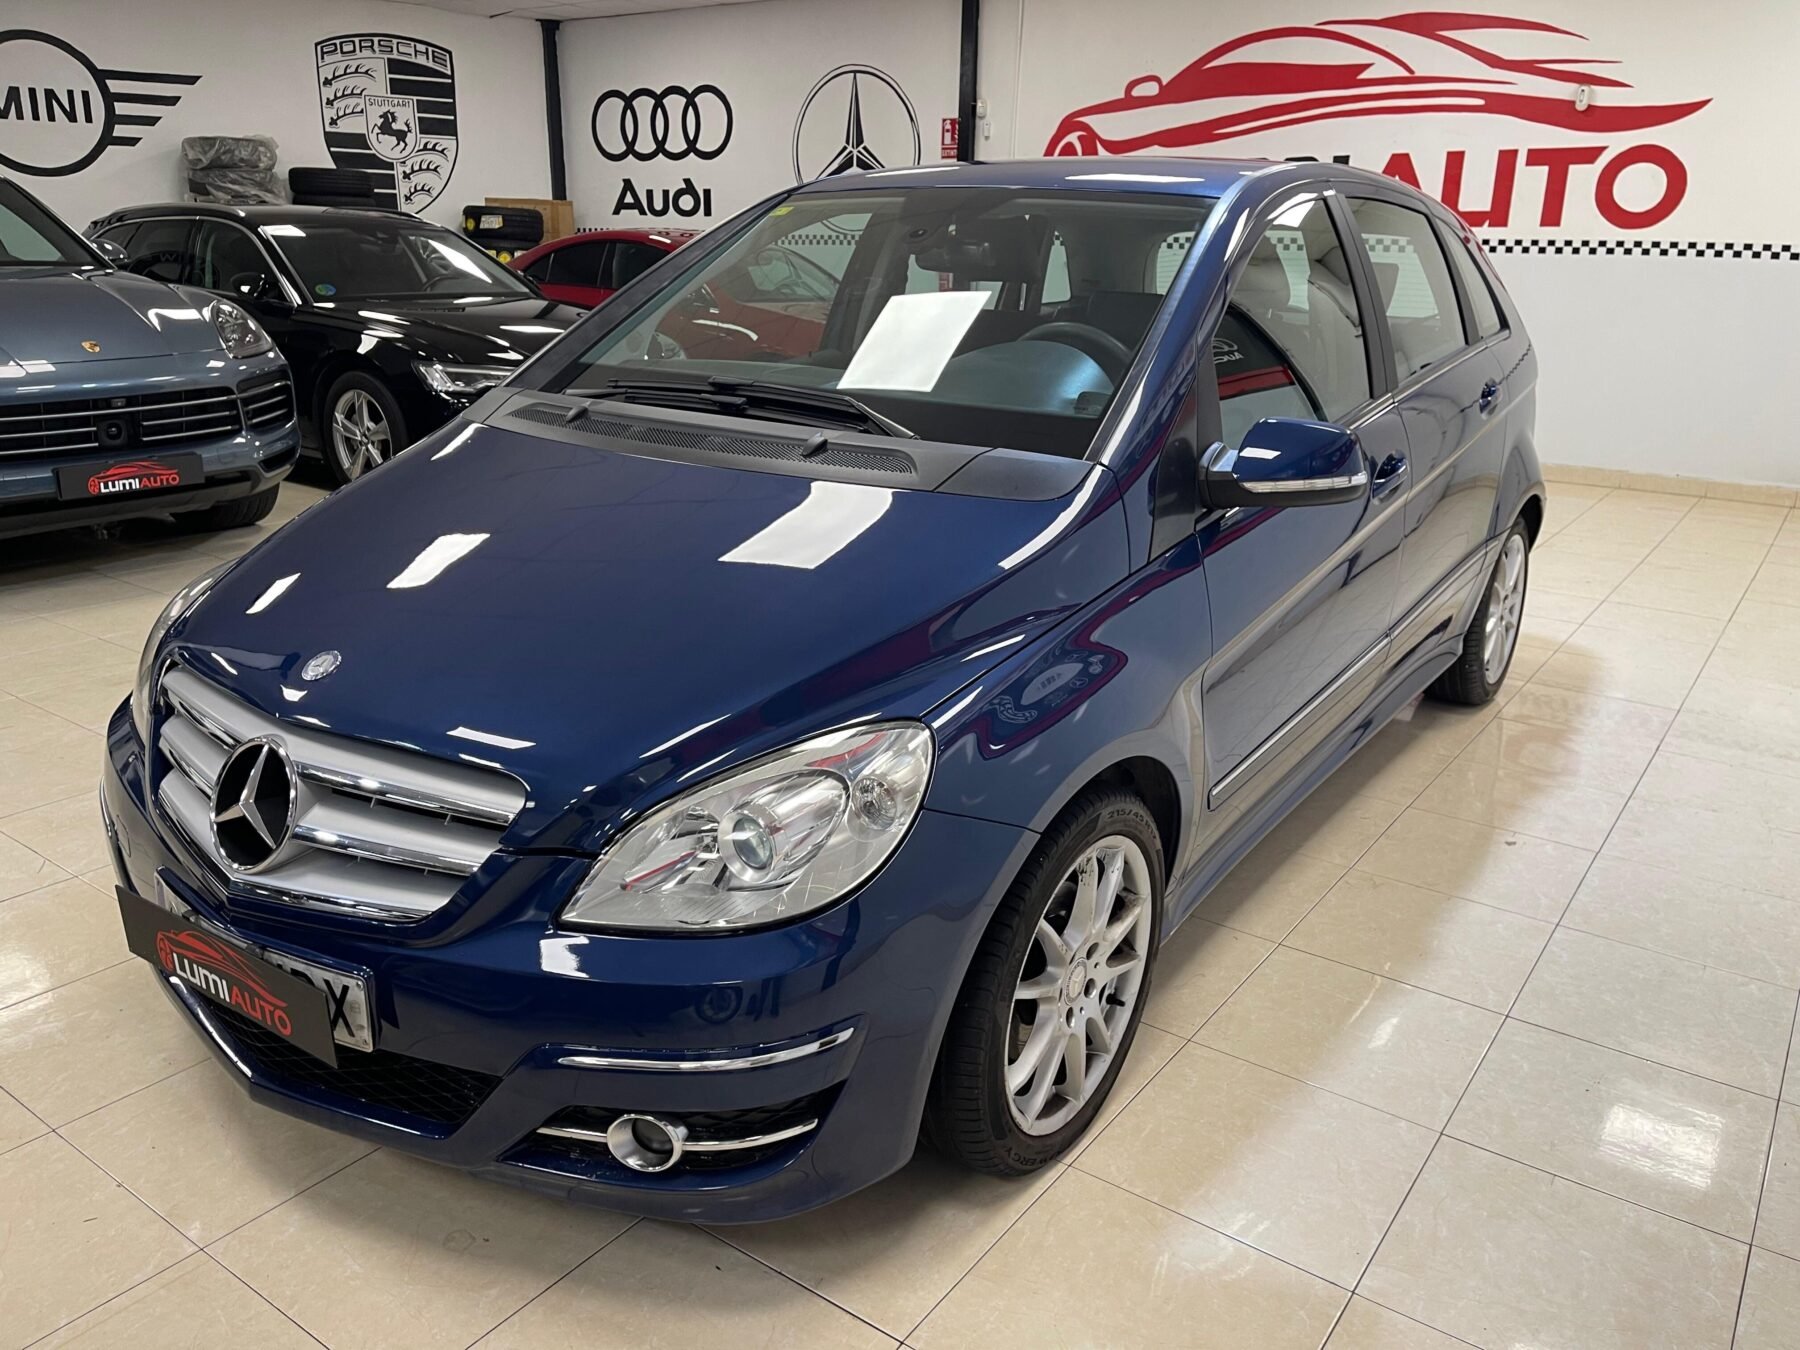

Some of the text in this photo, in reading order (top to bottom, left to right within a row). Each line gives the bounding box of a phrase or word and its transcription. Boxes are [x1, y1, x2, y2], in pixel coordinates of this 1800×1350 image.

[320, 39, 449, 69] PORSCHE
[368, 98, 410, 109] STUTTGART
[612, 178, 712, 217] Audi
